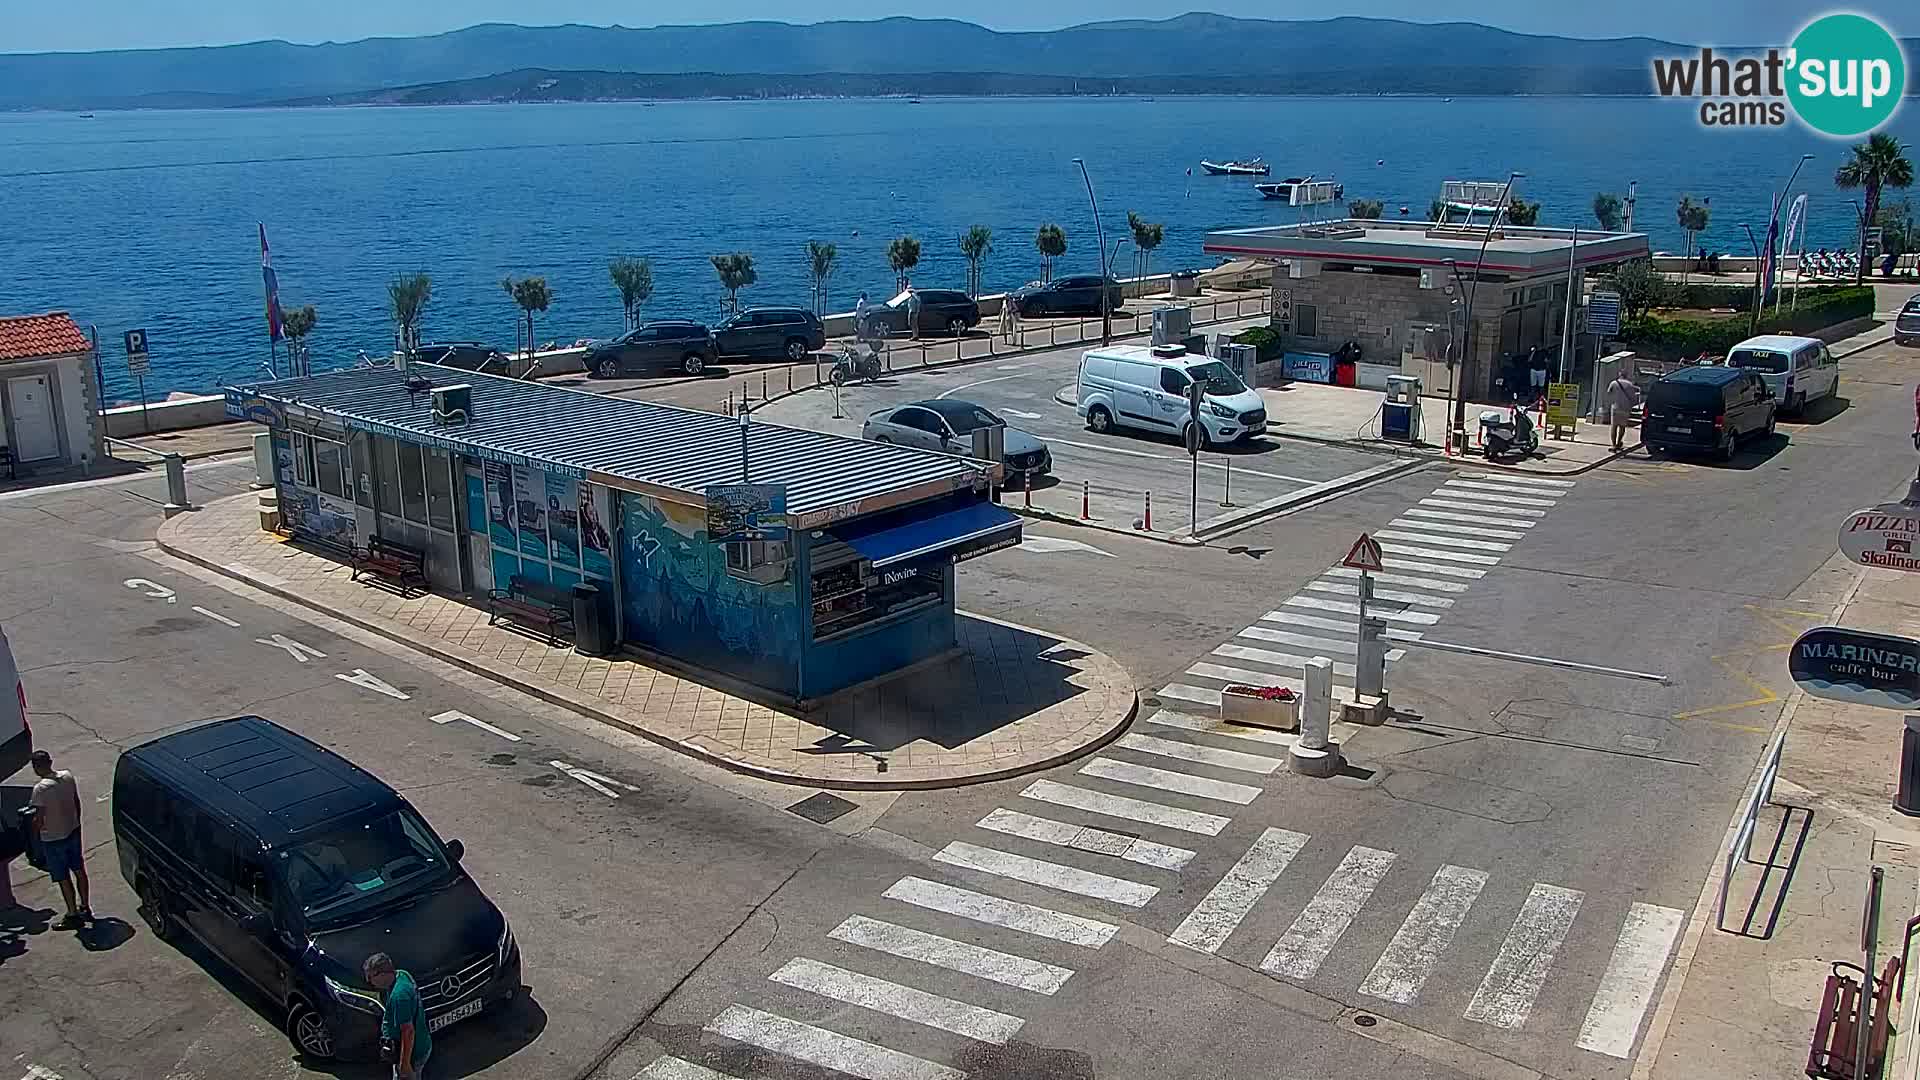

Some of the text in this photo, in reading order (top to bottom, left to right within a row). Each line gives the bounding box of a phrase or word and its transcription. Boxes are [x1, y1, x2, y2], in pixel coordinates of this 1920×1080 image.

[129, 333, 141, 351] P
[436, 439, 467, 452] POSTAJA
[478, 447, 493, 459] BUS
[493, 452, 527, 465] STATION
[527, 458, 553, 473] TICKET
[555, 465, 582, 479] OFFICE
[1849, 515, 1920, 534] PIZZE
[1801, 643, 1920, 674] MARINER
[1871, 666, 1898, 681] bar
